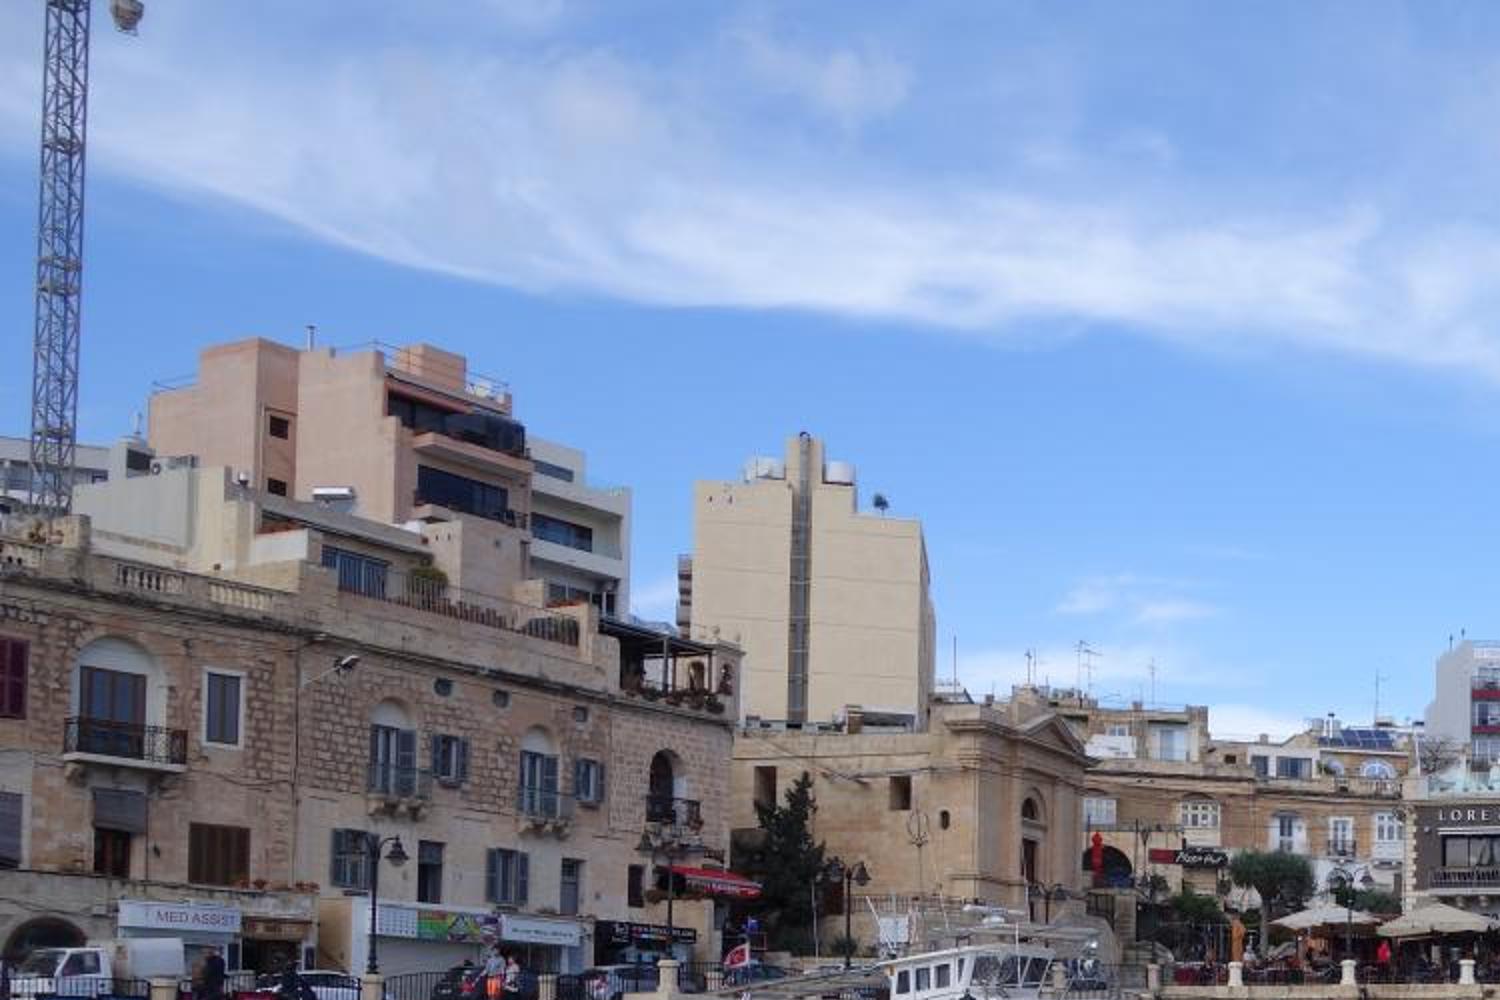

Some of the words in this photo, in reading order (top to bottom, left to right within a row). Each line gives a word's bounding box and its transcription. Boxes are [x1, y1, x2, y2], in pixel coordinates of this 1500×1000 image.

[1438, 808, 1489, 821] LORE
[156, 911, 189, 923] MED
[192, 914, 236, 927] ASSIST
